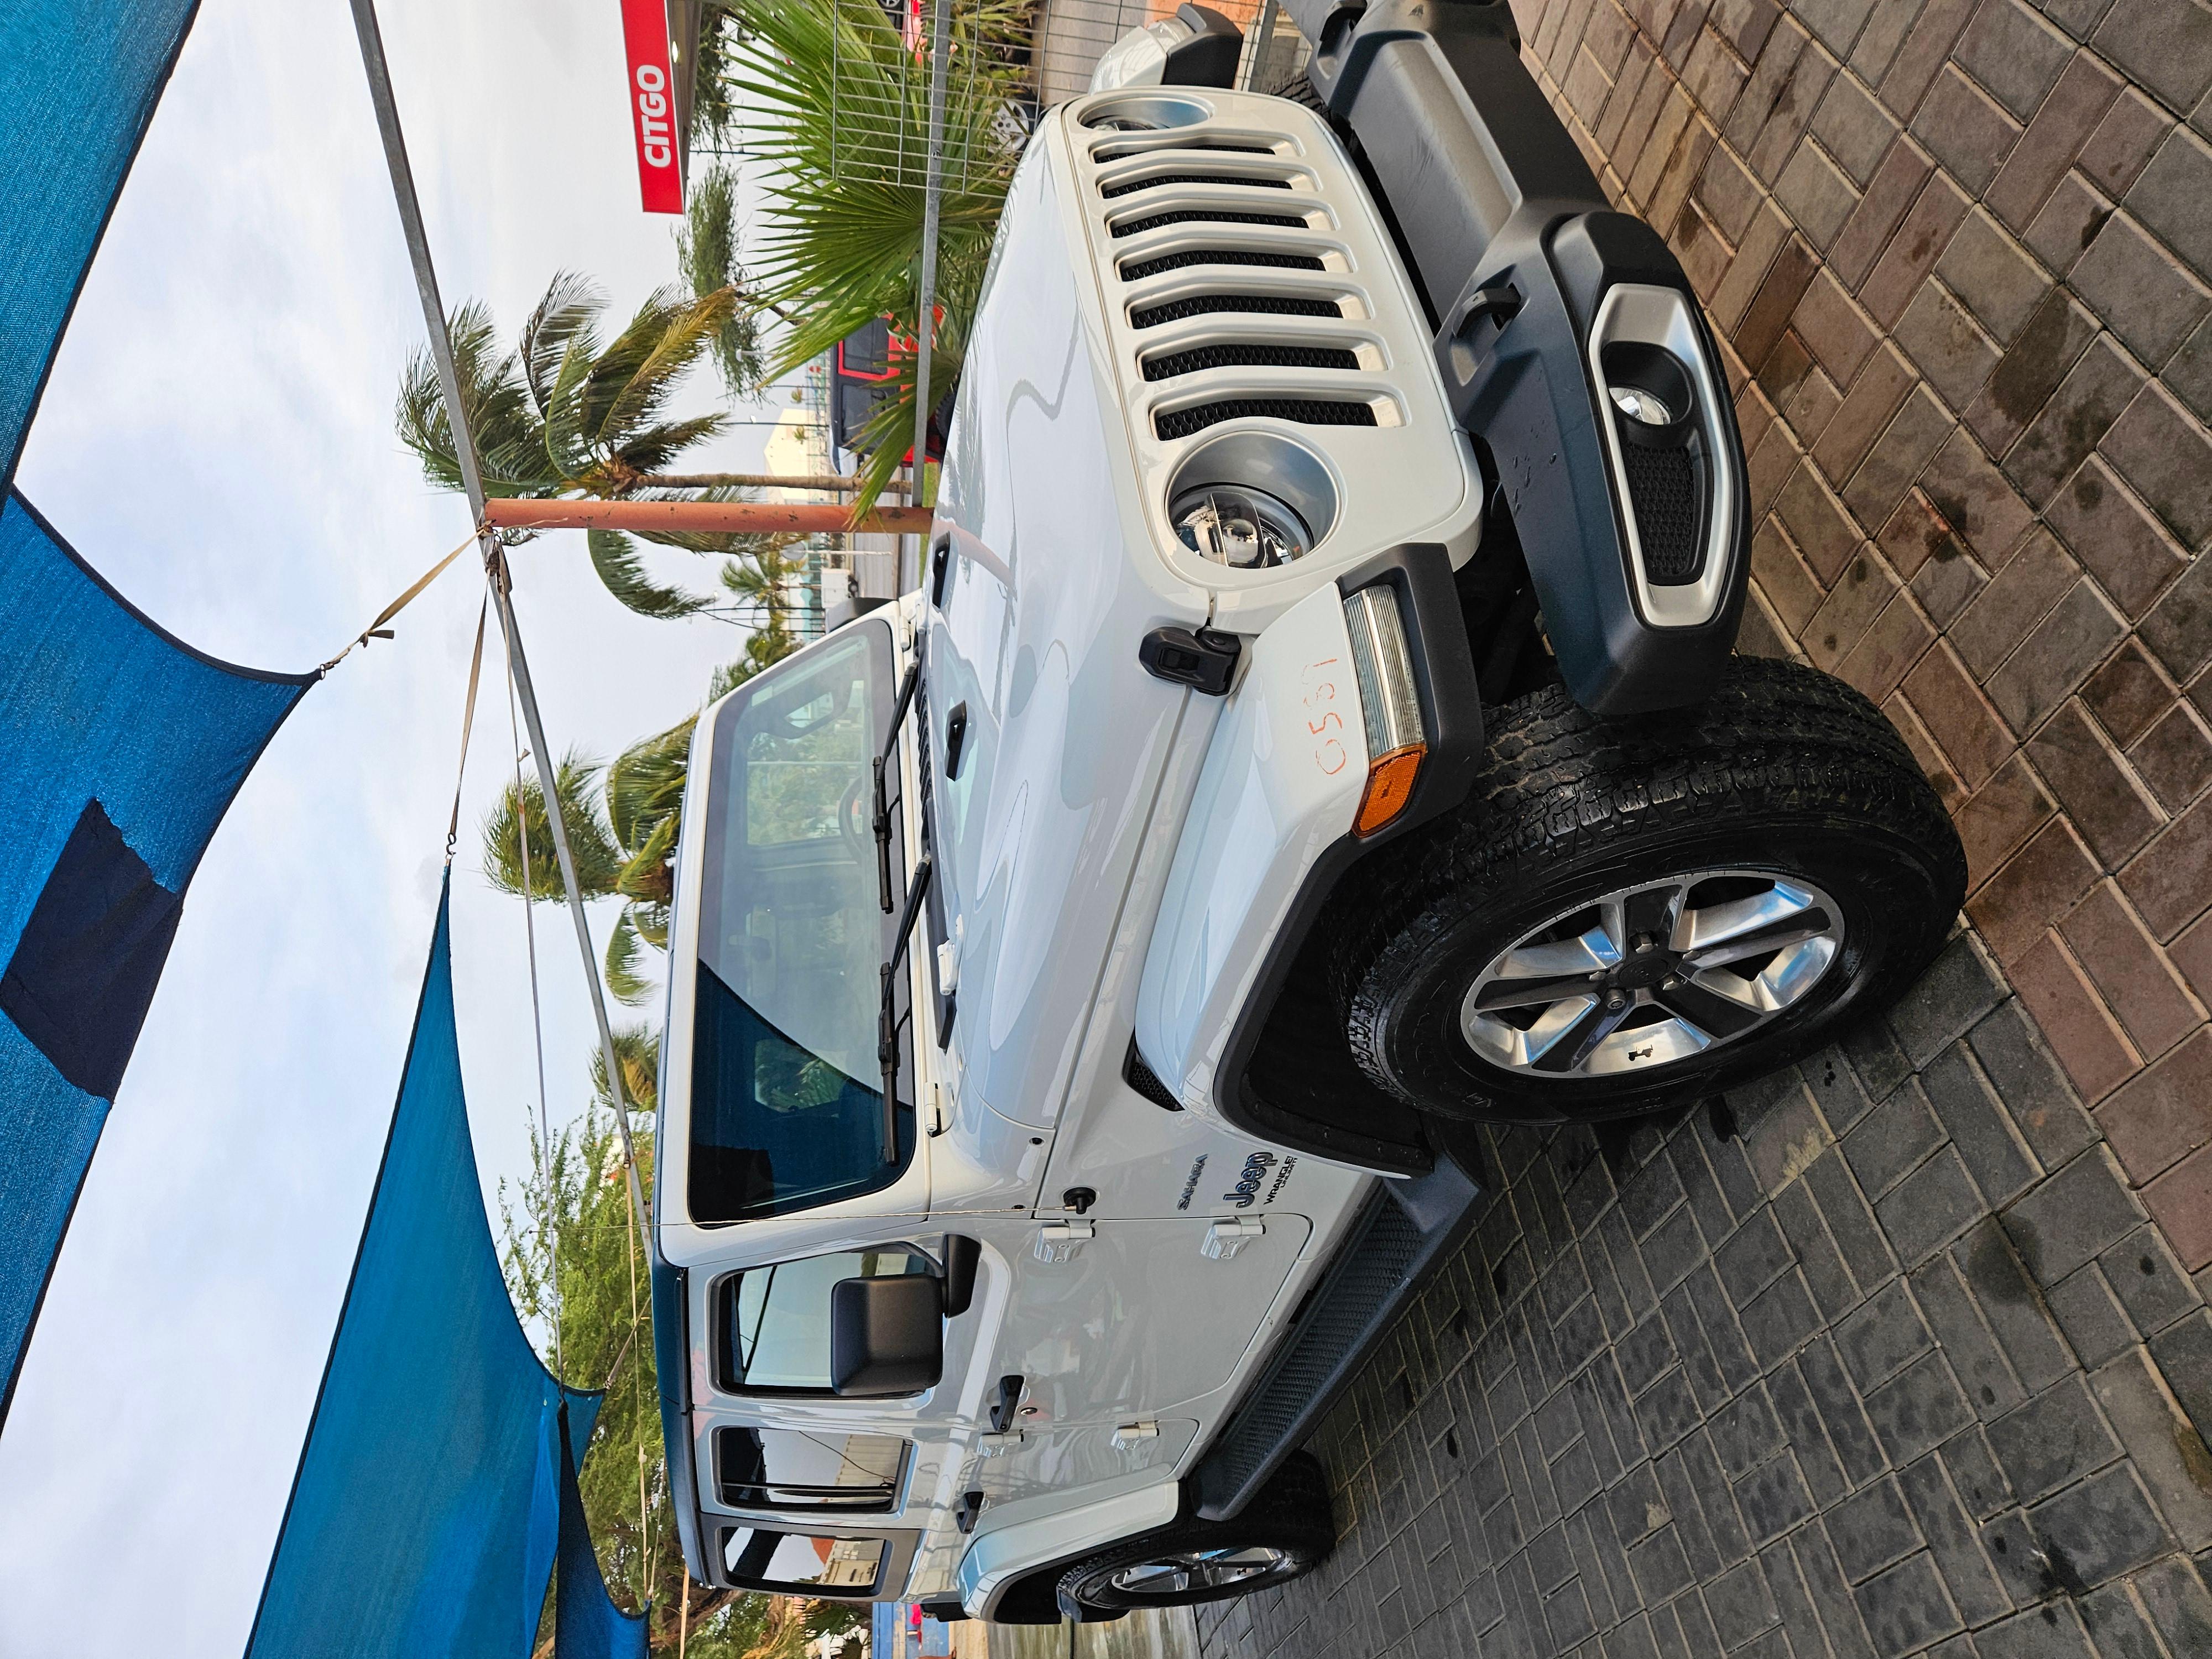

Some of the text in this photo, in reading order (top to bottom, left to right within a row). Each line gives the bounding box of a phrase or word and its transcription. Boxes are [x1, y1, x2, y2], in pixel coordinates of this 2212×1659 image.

[637, 65, 671, 168] CITGO
[1177, 1154, 1208, 1211] SAHARA
[1224, 1152, 1278, 1208] Jeep
[1264, 1156, 1293, 1205] WRANGLE
[1280, 1157, 1298, 1188] UNLIMIT
